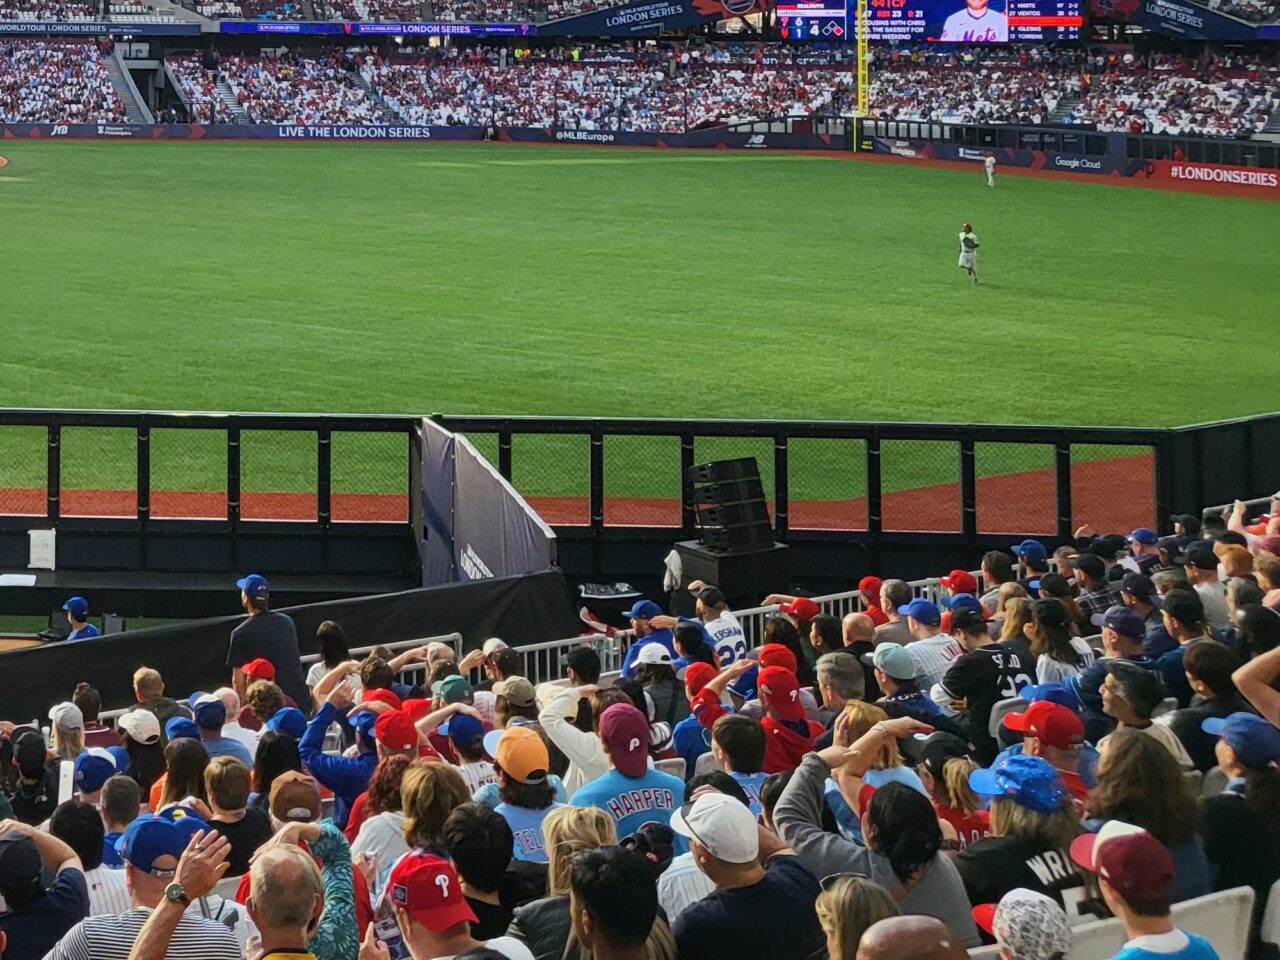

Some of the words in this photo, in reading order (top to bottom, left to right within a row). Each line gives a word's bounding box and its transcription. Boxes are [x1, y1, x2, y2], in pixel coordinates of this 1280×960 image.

[606, 12, 649, 27] LONDON
[650, 5, 684, 20] SERIES
[796, 16, 803, 26] 6
[1146, 2, 1176, 20] LONDON
[1177, 10, 1203, 28] SERIES
[810, 24, 820, 36] 4
[50, 125, 68, 136] JTB
[279, 126, 305, 137] LIVE
[308, 127, 330, 137] THE
[333, 127, 386, 138] LONDON
[388, 127, 430, 138] SERIES
[556, 130, 614, 142] @MLBEurope
[1055, 156, 1080, 168] Google
[1080, 158, 1101, 168] Cloud
[1170, 166, 1278, 186] #LONDONSERIES
[718, 640, 746, 668] 22
[607, 788, 675, 822] HARPER
[434, 874, 449, 898] P
